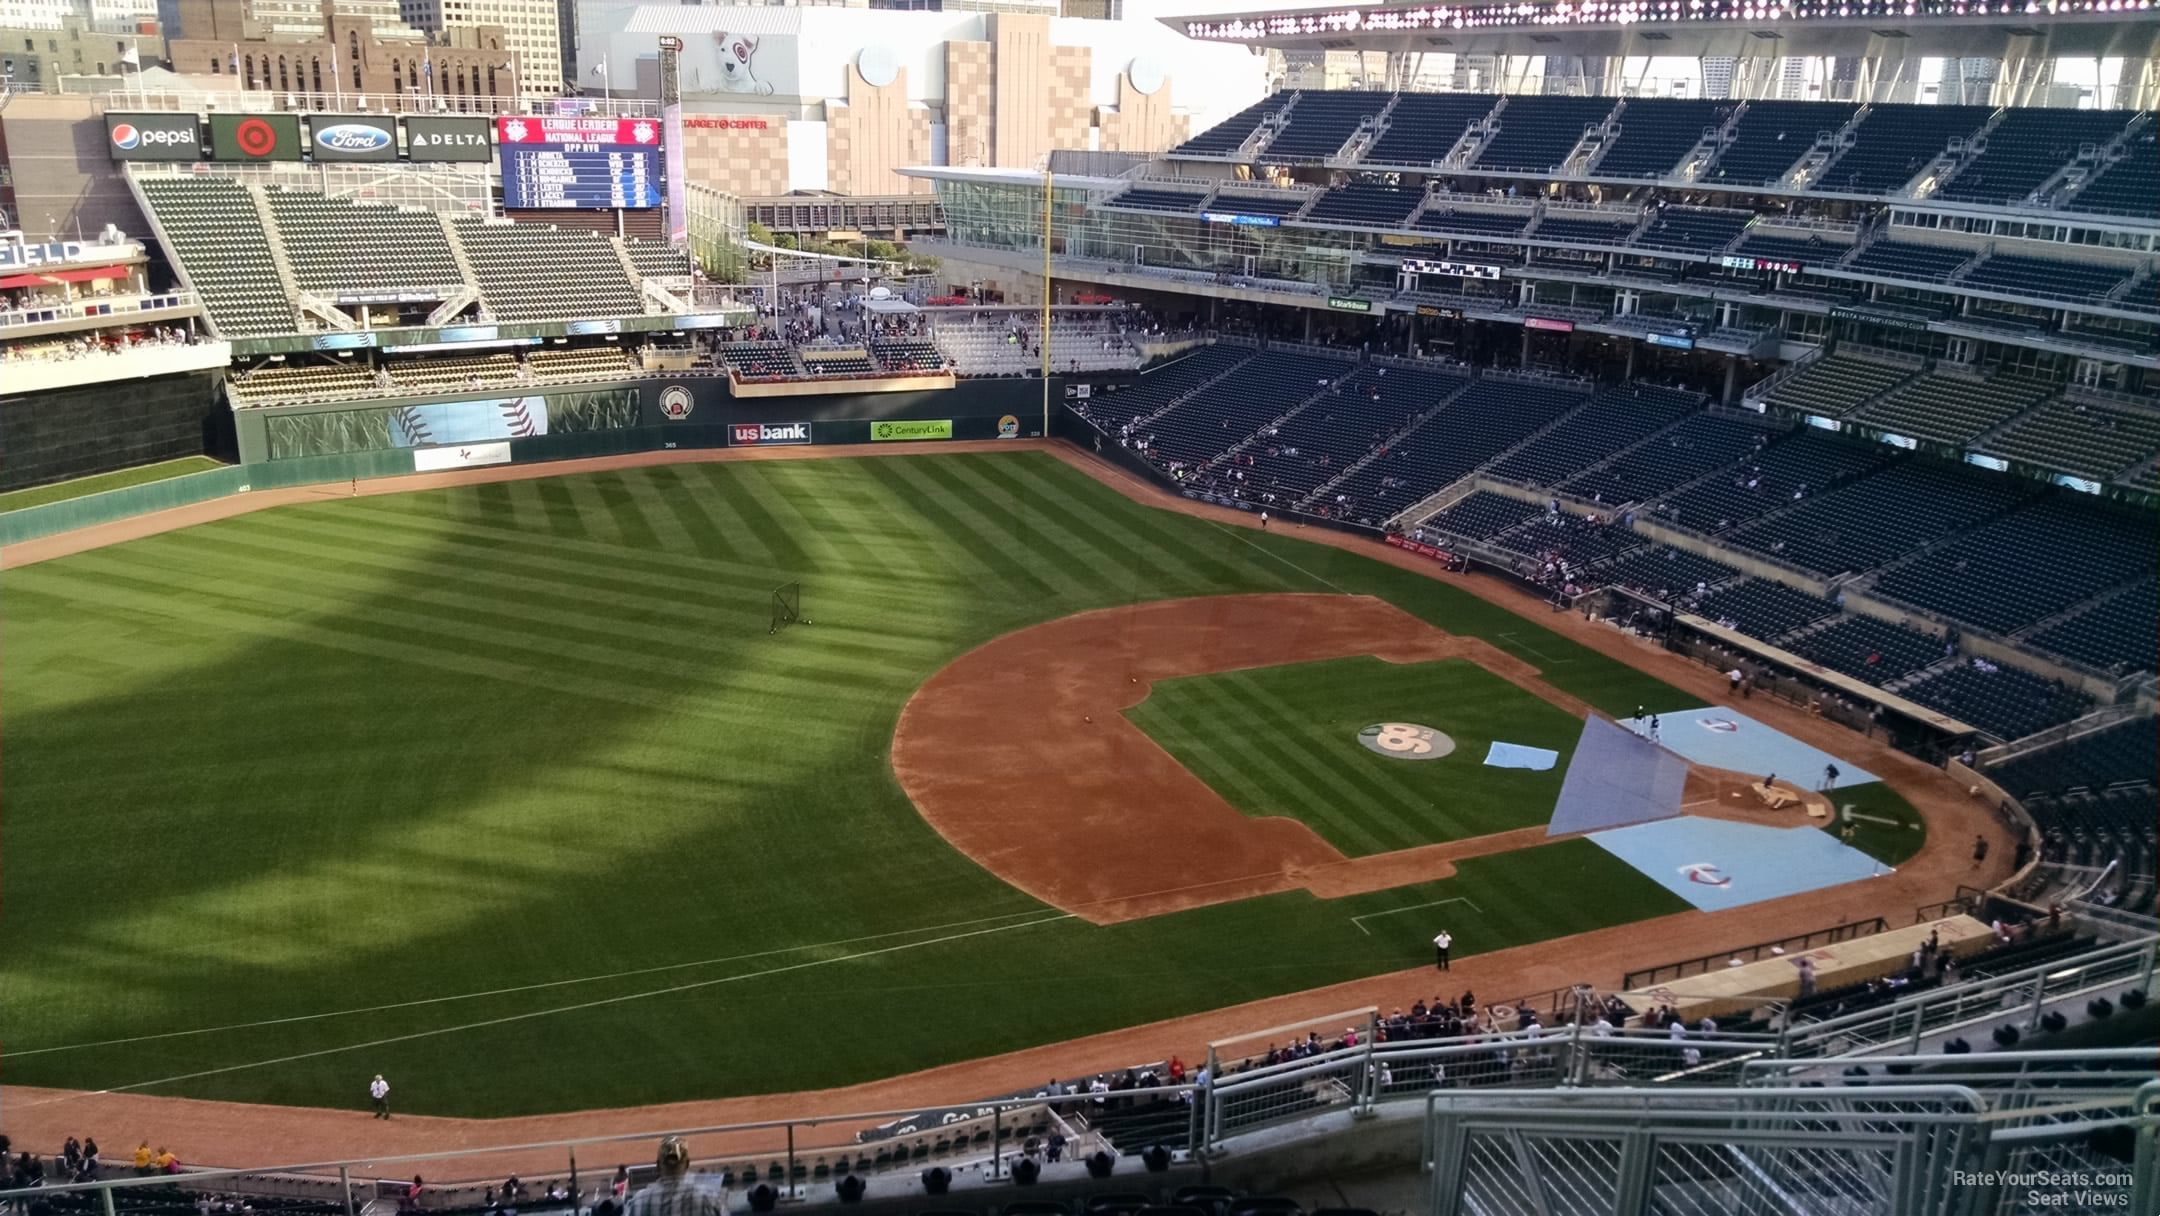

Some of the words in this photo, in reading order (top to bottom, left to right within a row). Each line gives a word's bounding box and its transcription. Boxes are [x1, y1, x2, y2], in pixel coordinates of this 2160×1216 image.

[541, 119, 577, 131] LEAGUE
[577, 119, 619, 132] LEADERS
[683, 119, 718, 128] TARGET
[729, 120, 767, 129] CENTER
[142, 127, 195, 146] pepsi
[332, 126, 377, 149] Ford
[430, 131, 486, 147] DELTA
[545, 132, 584, 143] NATIONAL
[586, 133, 617, 144] LEAGUE
[1837, 311, 1857, 320] DELTA
[895, 424, 945, 435] CenturyLink
